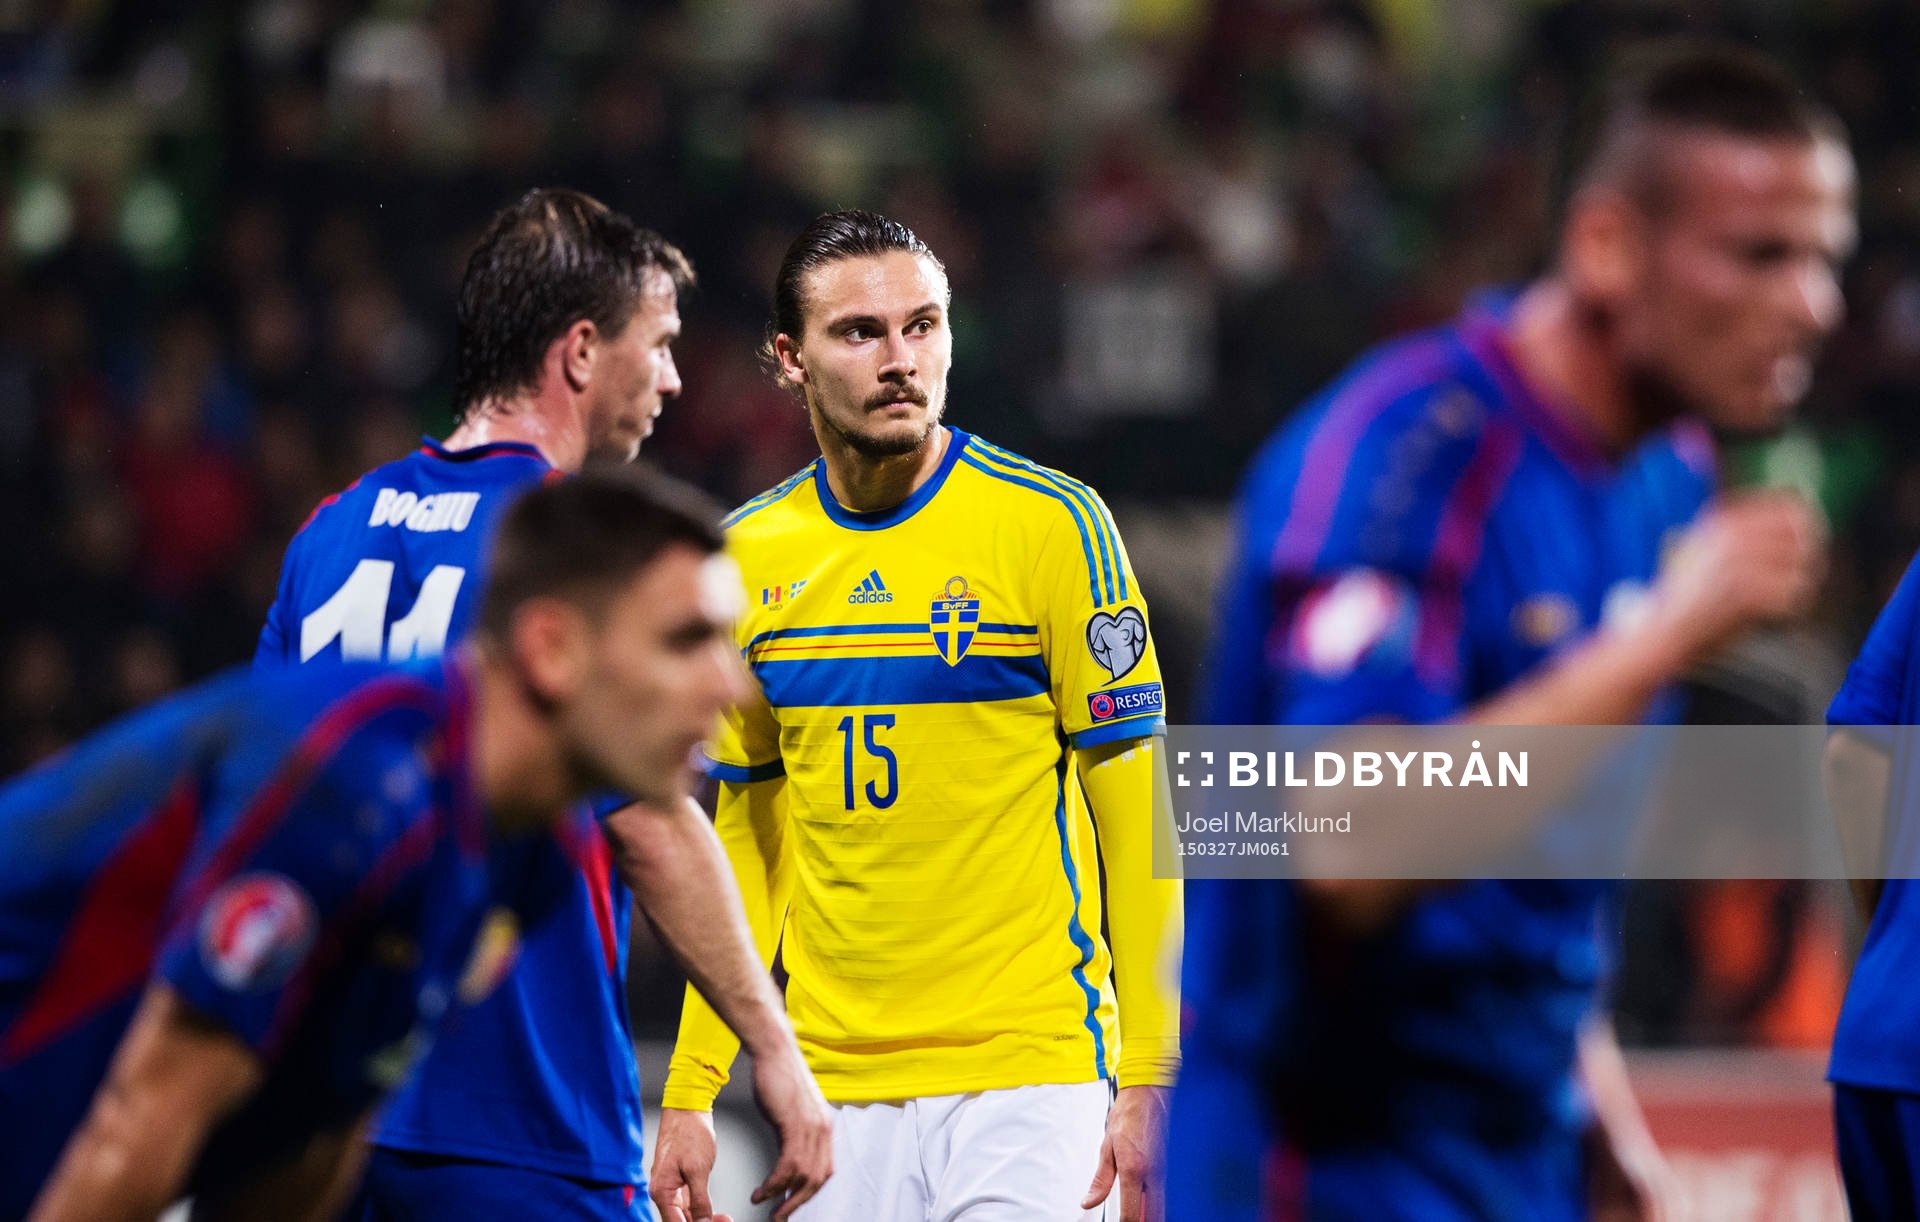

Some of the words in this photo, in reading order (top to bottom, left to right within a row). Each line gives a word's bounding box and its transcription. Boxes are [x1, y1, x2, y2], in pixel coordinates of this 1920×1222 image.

[848, 590, 893, 604] adidas
[942, 601, 969, 610] SvFF
[301, 559, 466, 662] 11
[1115, 690, 1162, 710] RESPECT
[838, 713, 899, 811] 15
